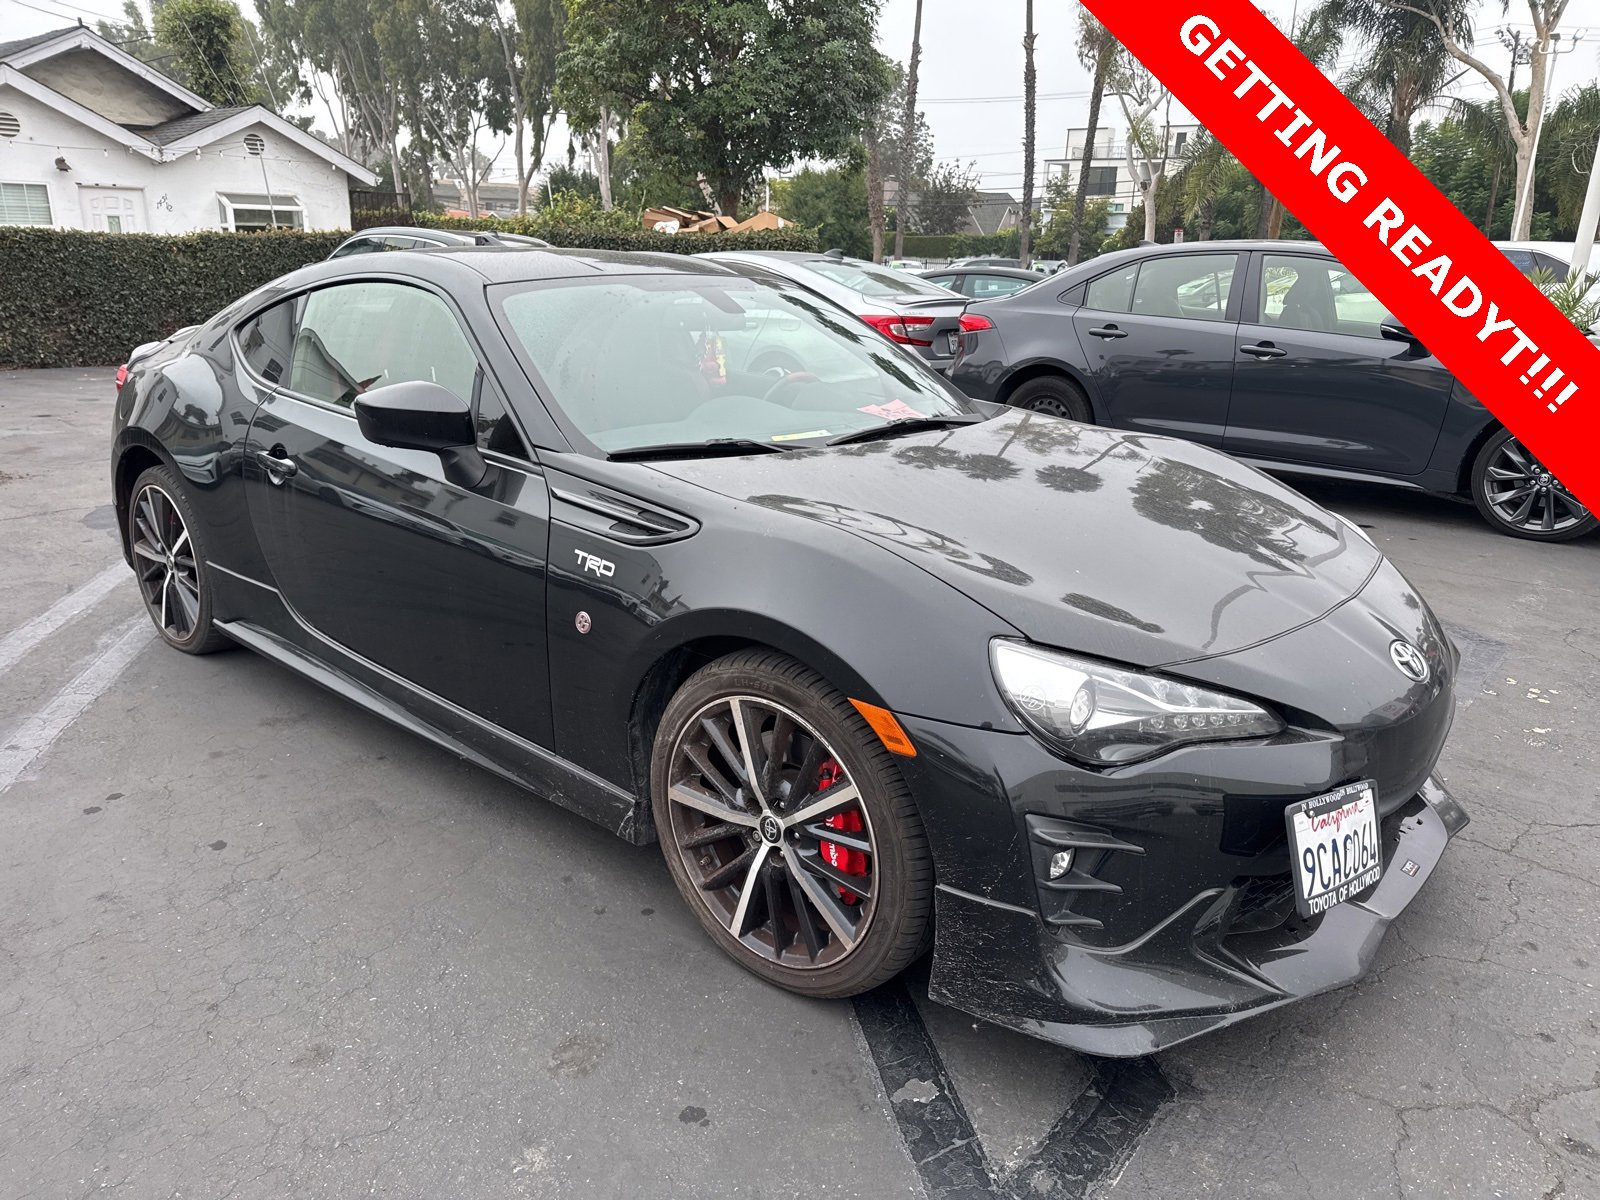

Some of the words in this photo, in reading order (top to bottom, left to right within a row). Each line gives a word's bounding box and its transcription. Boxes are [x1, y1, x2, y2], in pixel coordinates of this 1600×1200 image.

[574, 548, 615, 577] TRD
[1308, 791, 1341, 809] HOLLYWOOD
[1311, 801, 1364, 833] California
[1303, 819, 1377, 897] 9CAC064
[1308, 890, 1337, 915] TOYOTA
[1338, 884, 1348, 903] OF
[1348, 865, 1380, 898] HOLLYWOOD
